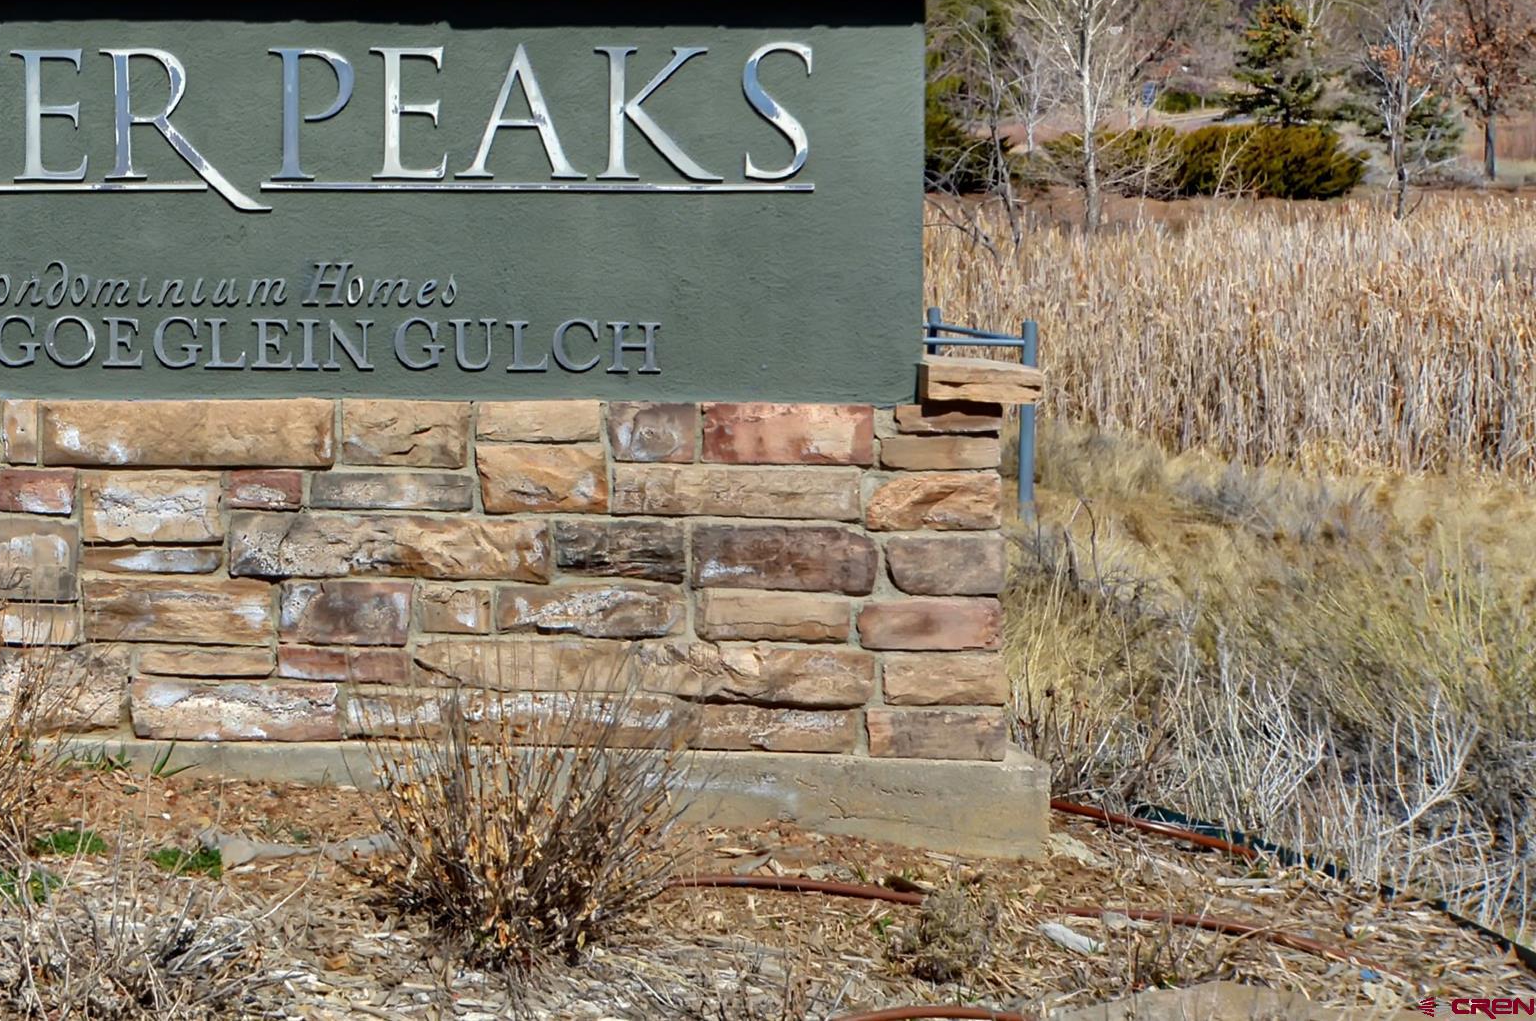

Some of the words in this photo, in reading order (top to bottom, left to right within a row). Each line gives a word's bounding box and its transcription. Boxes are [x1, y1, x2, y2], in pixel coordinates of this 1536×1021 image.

[267, 41, 816, 182] PEAKS
[304, 262, 458, 308] Homes
[393, 318, 662, 374] GULCH
